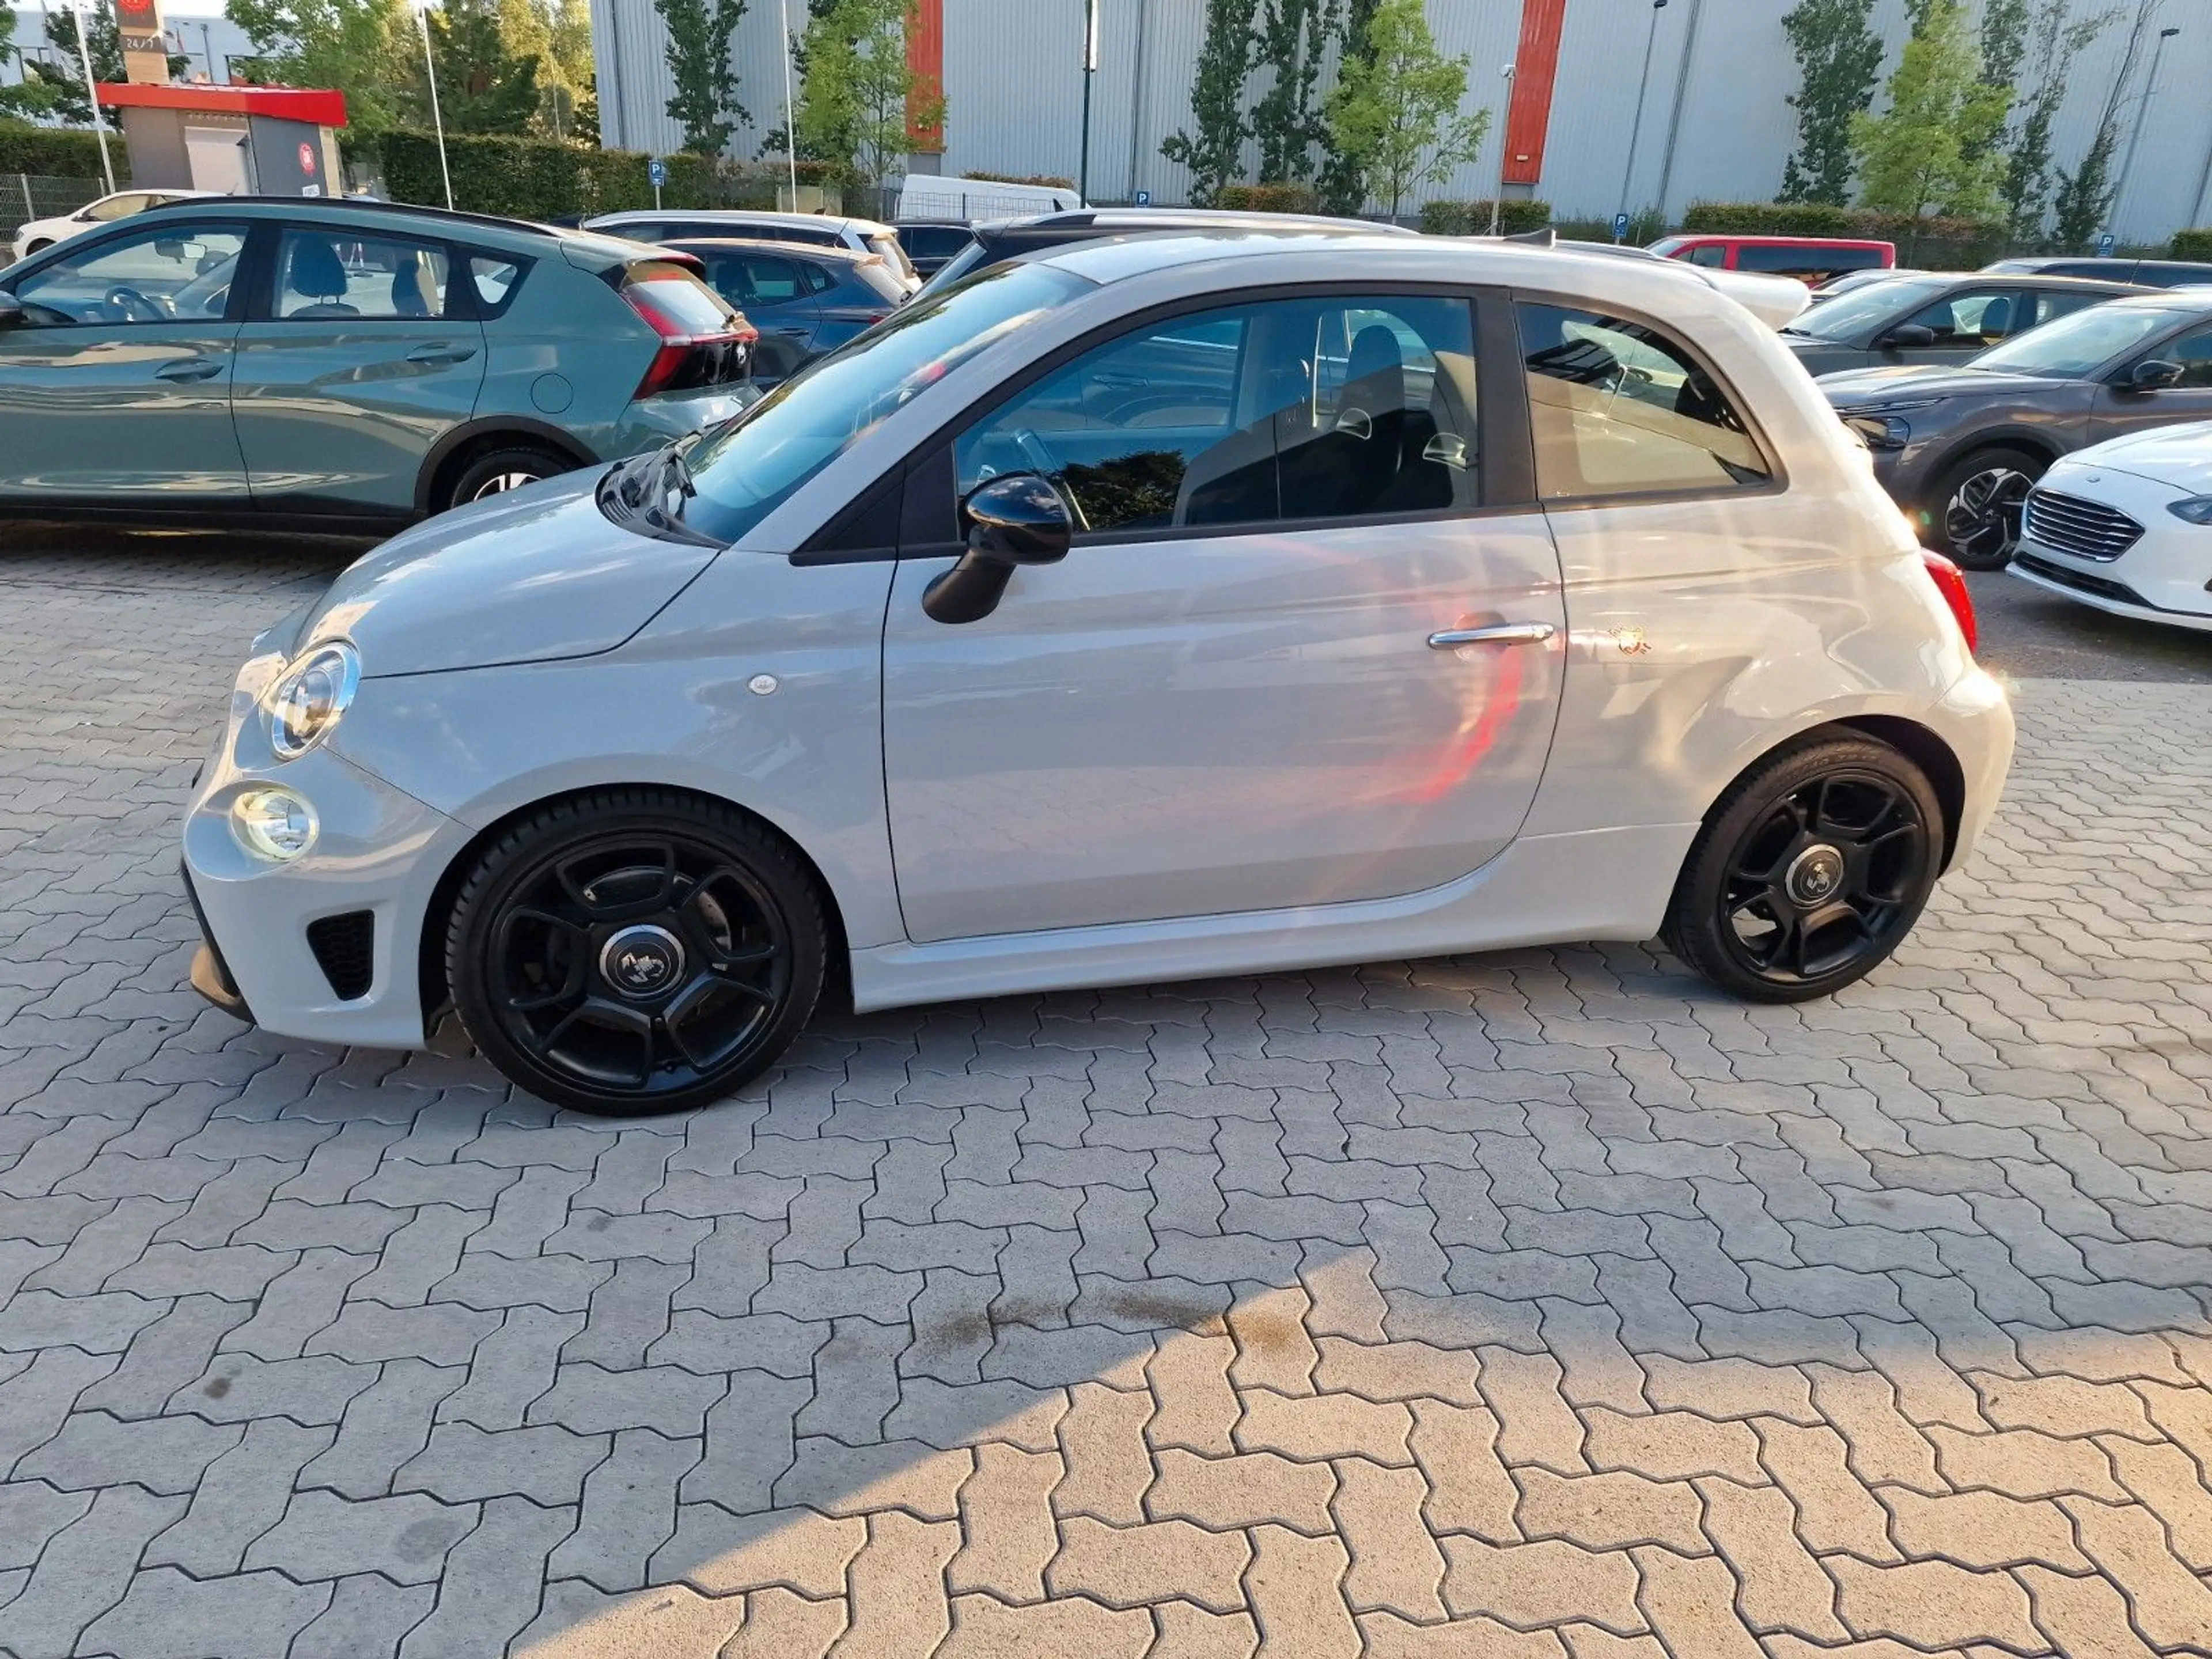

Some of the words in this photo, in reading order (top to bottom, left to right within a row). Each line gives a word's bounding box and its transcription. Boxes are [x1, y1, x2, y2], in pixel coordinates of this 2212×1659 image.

[652, 164, 660, 174] P
[1139, 193, 1147, 203] P
[1618, 215, 1626, 225] P
[2103, 237, 2112, 247] P
